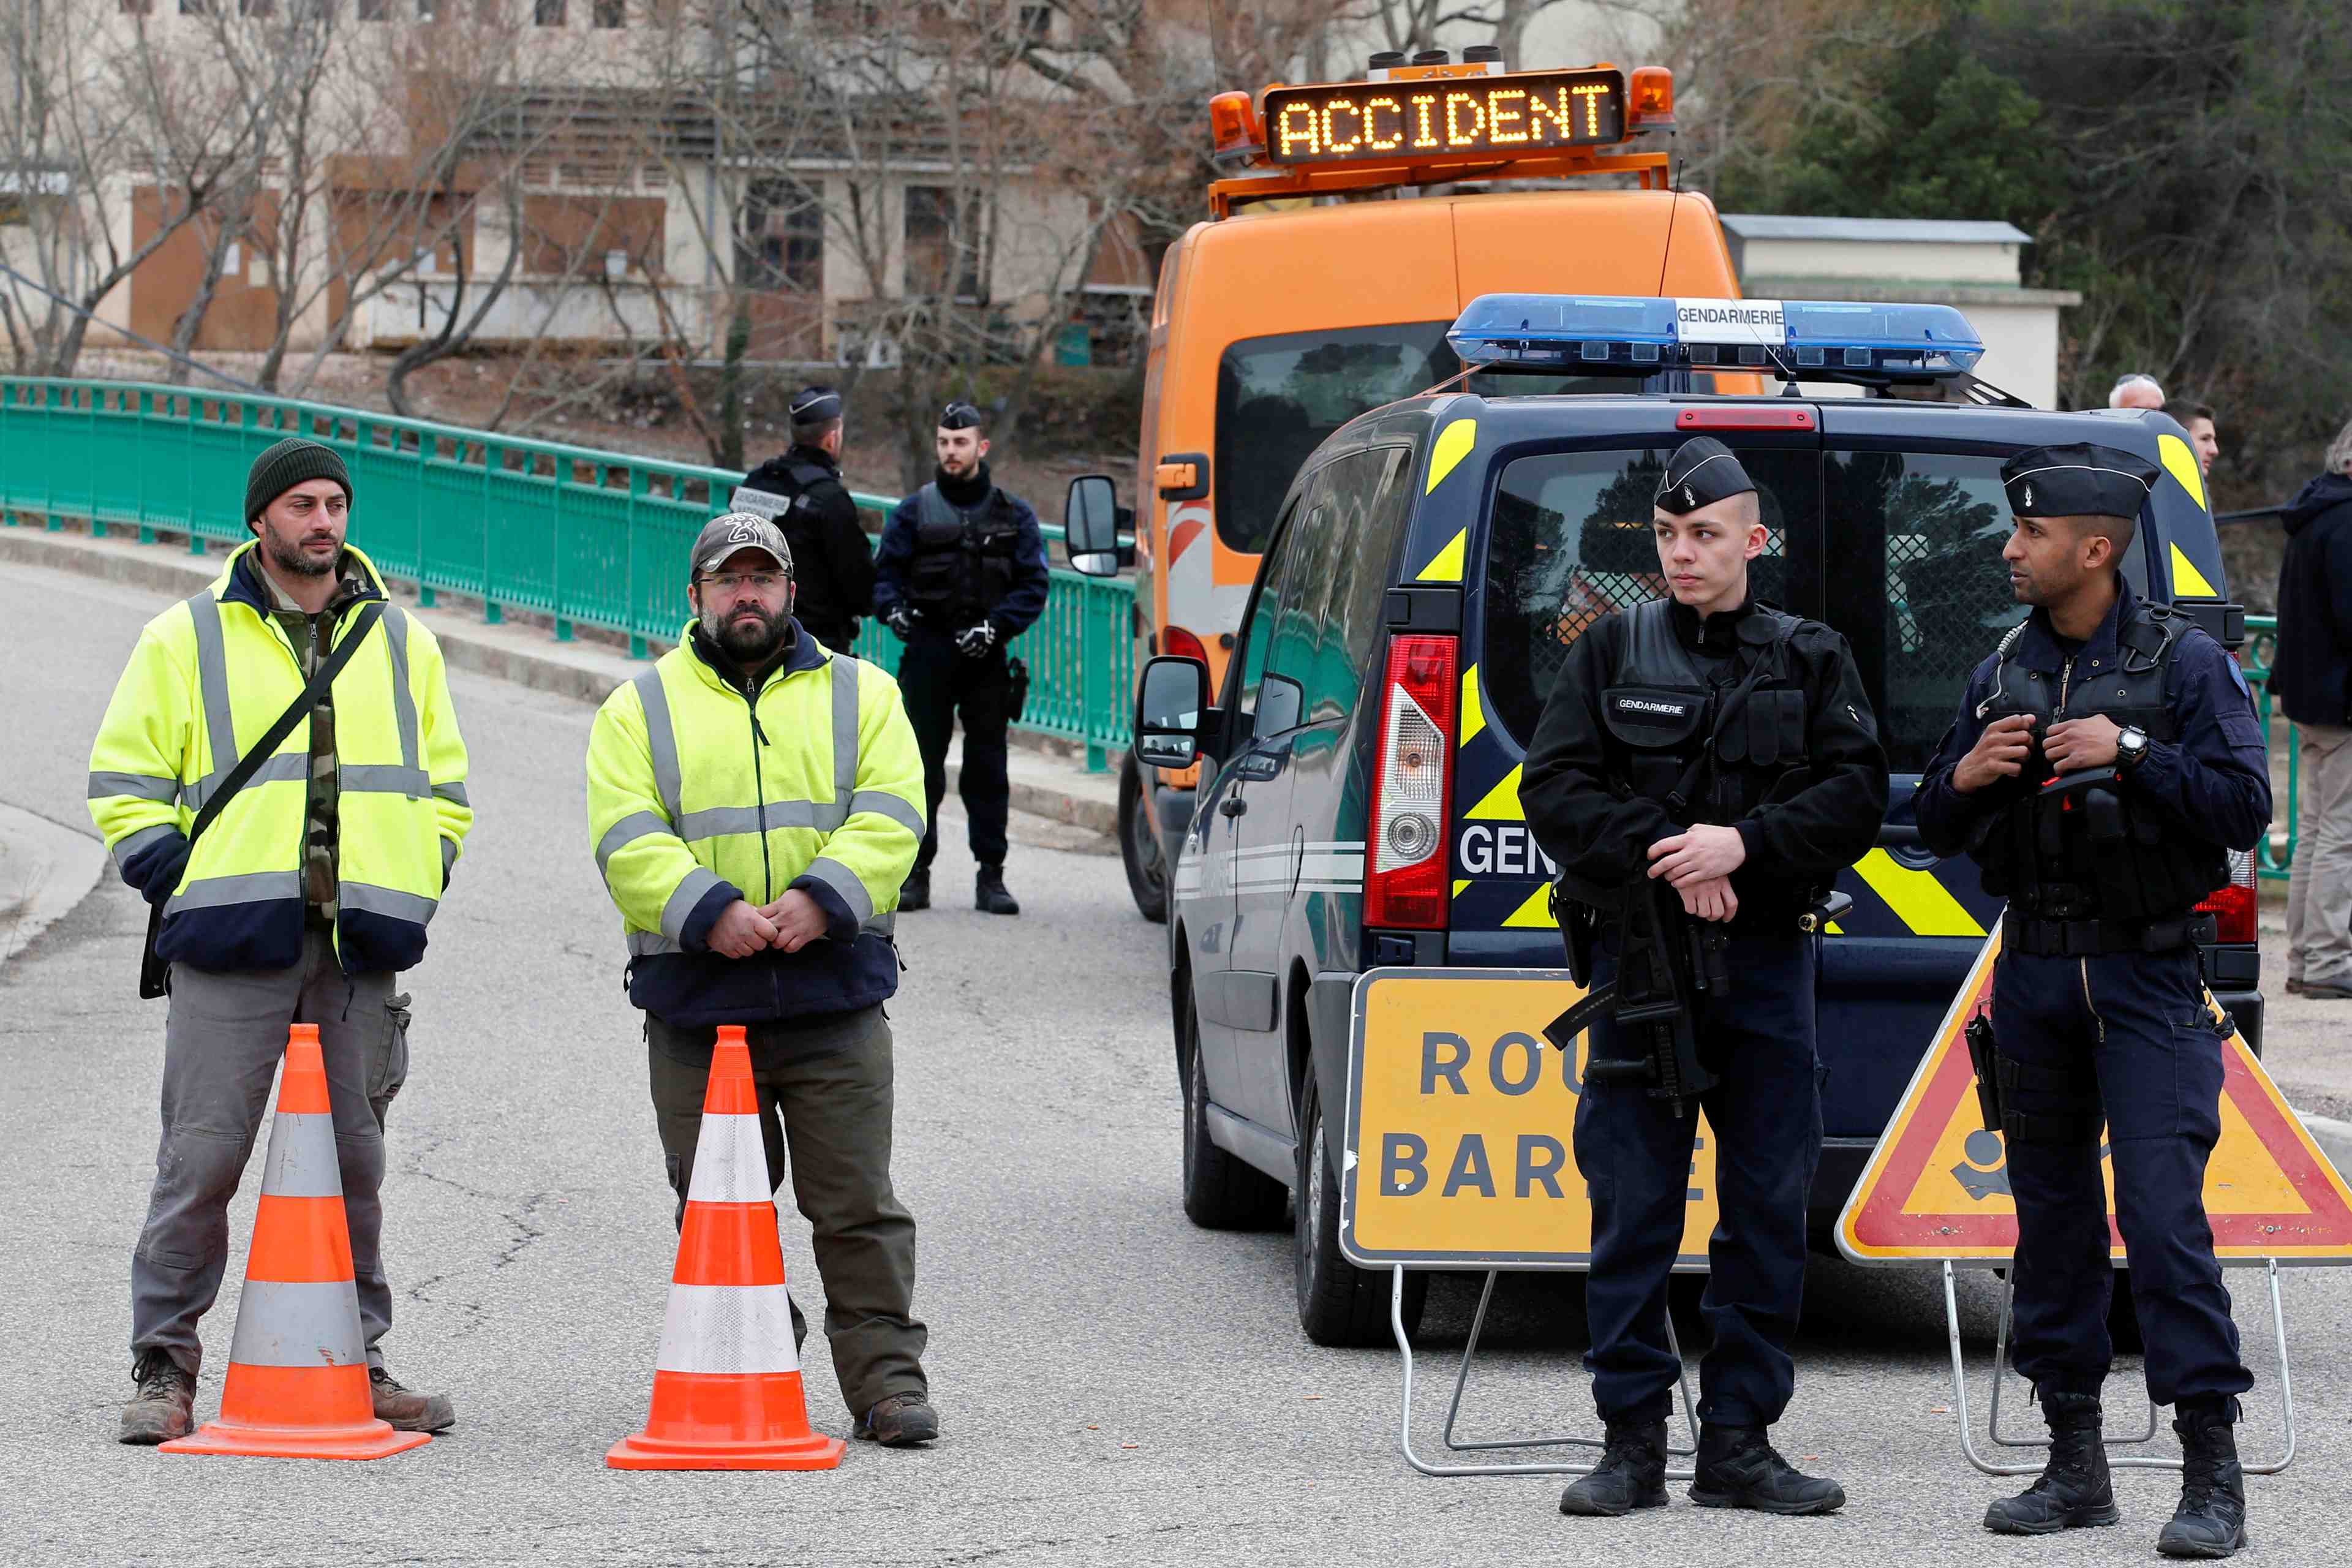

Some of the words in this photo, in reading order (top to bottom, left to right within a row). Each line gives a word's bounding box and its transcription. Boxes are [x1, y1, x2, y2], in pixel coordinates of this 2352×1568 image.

[1279, 85, 1610, 156] ACCIDENT
[1678, 307, 1784, 325] GENDARMERIE
[1619, 699, 1683, 715] GENDARMERIE
